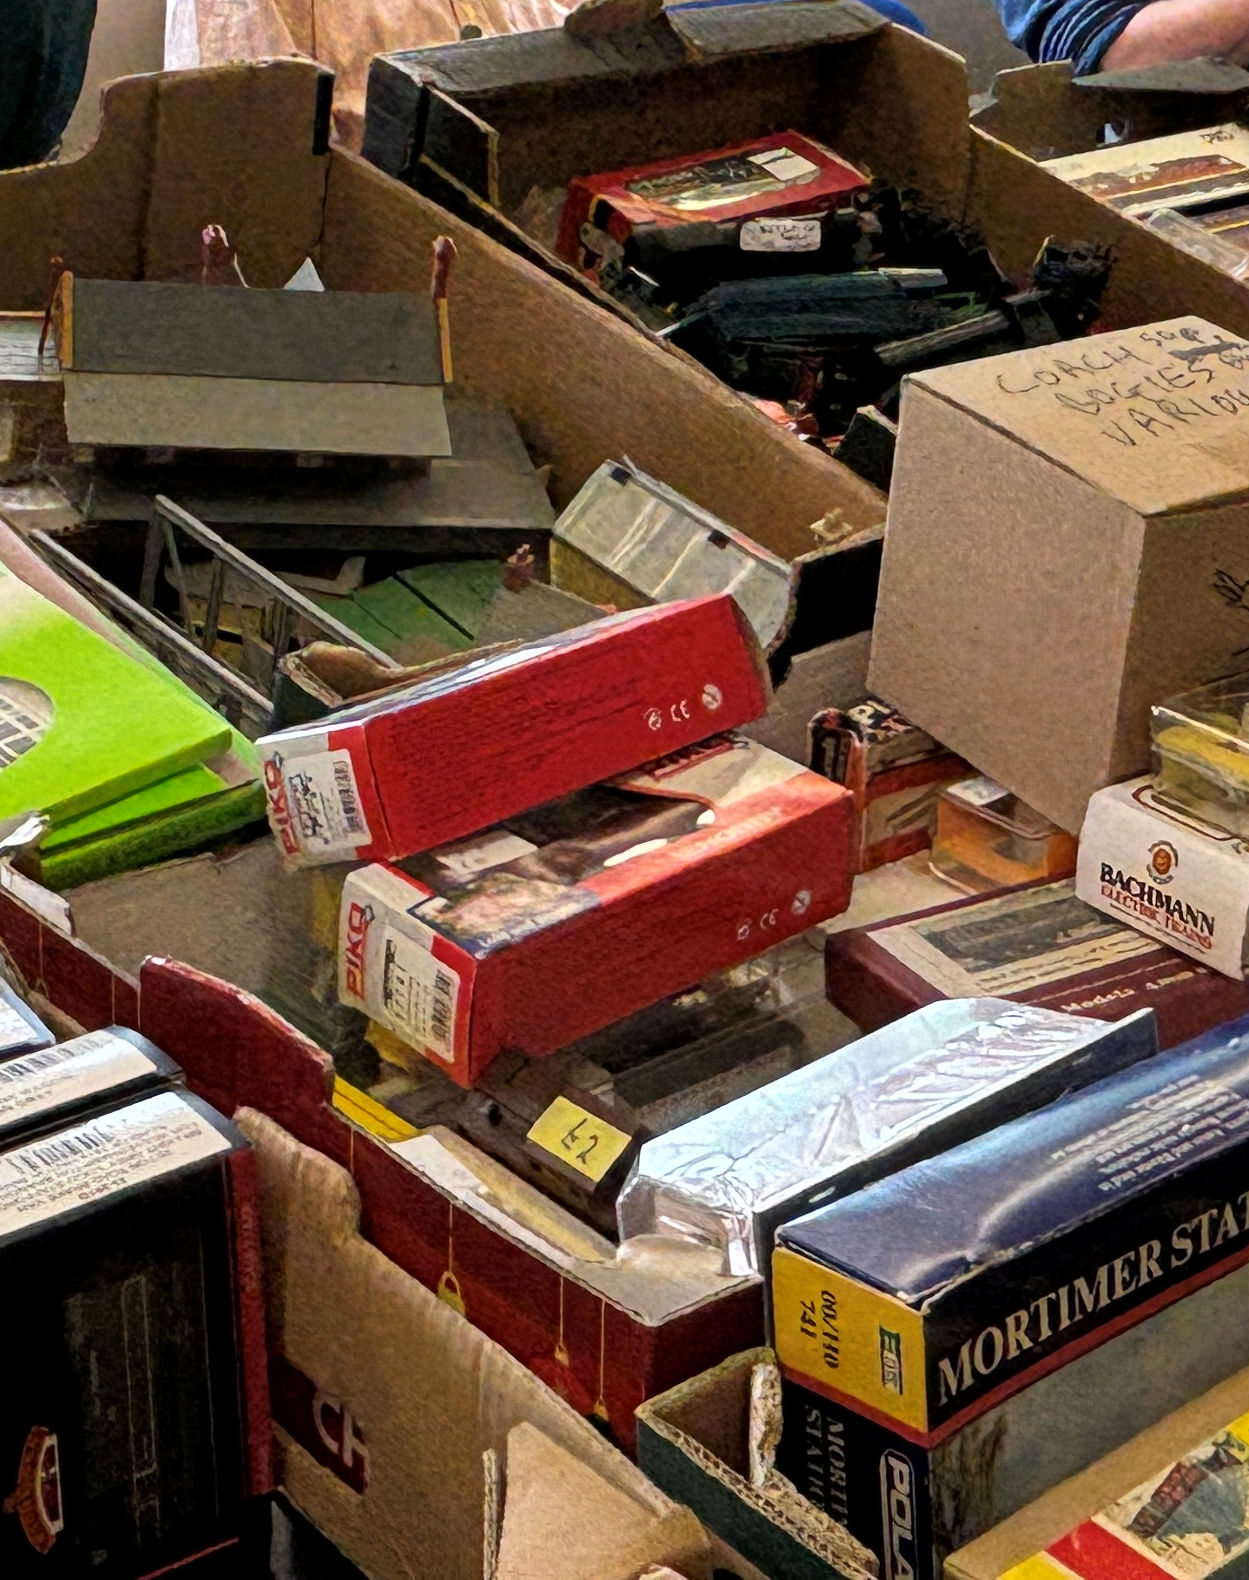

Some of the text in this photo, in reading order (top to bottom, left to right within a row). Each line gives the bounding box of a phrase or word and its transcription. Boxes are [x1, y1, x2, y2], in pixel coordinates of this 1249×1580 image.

[996, 344, 1153, 395] COACH
[264, 759, 298, 855] PIKO
[1101, 861, 1216, 937] BACHMANN
[346, 901, 370, 1002] PIKO
[936, 1239, 1165, 1407] MORTIMER
[887, 1454, 915, 1580] POLA
